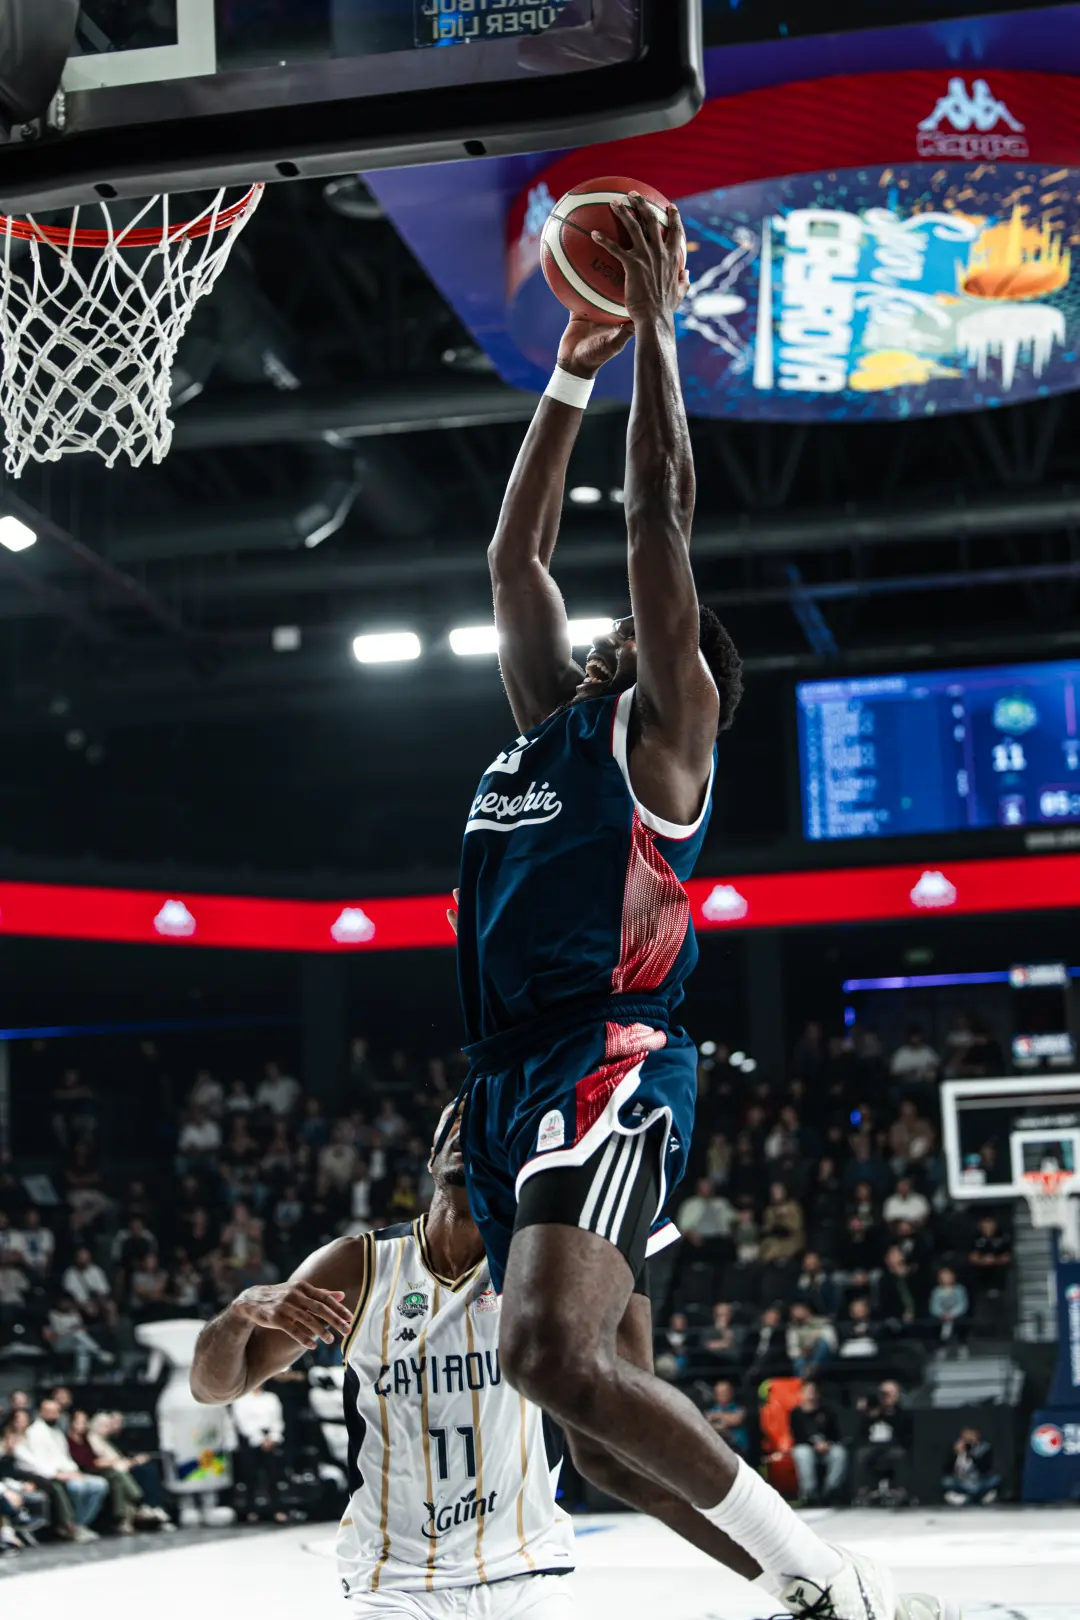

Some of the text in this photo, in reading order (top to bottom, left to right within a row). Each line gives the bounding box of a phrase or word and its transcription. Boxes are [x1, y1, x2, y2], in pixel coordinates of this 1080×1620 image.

[374, 1348, 501, 1397] ÇAYIROV
[428, 1425, 477, 1481] 11
[436, 1489, 498, 1532] Glint
